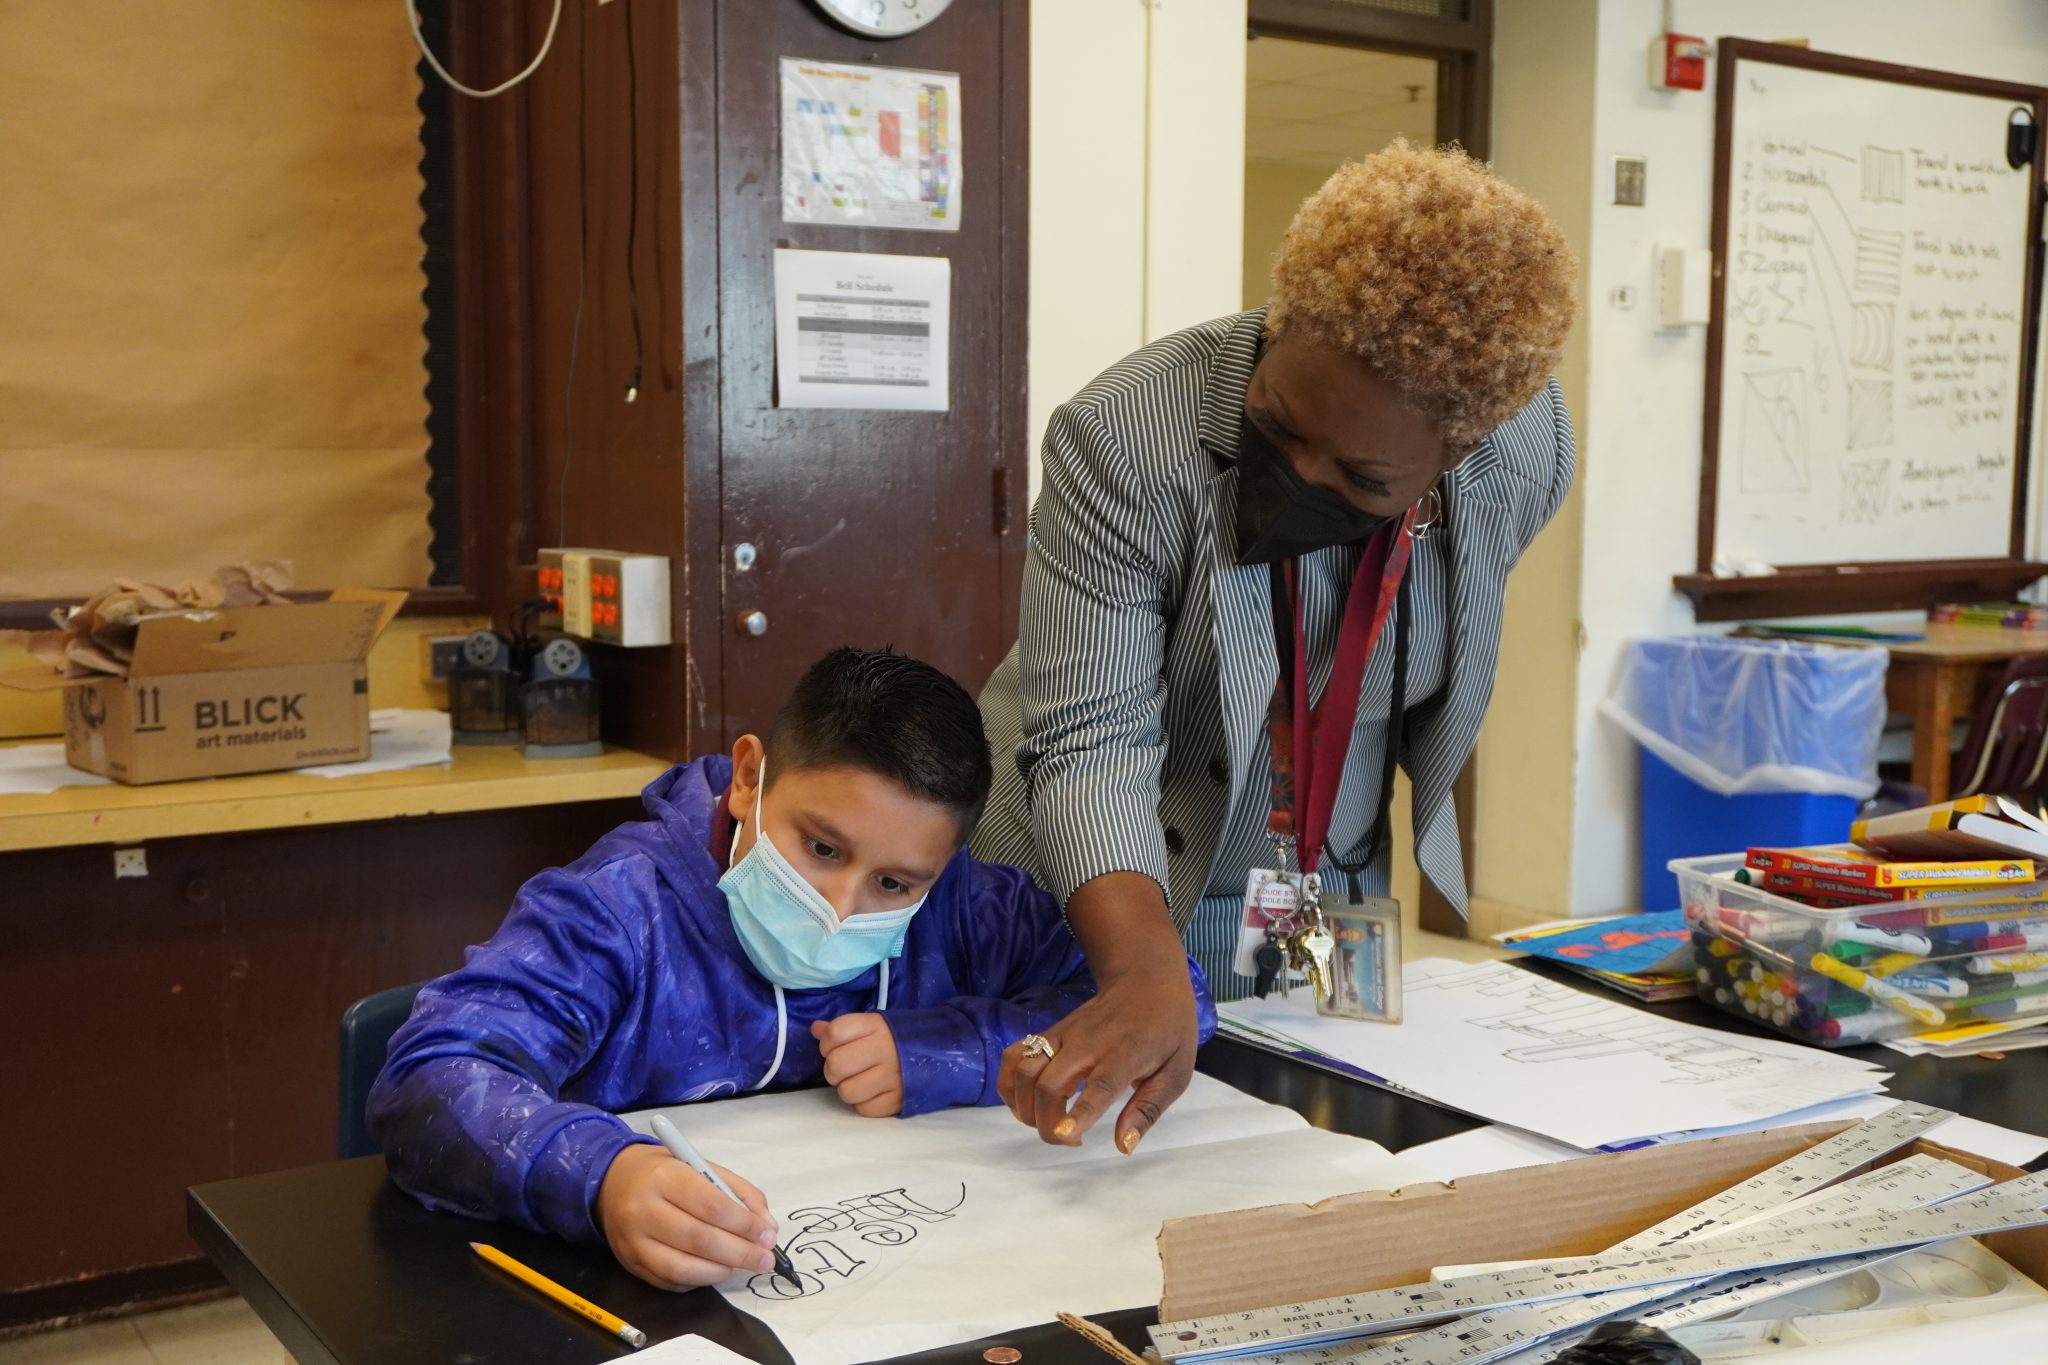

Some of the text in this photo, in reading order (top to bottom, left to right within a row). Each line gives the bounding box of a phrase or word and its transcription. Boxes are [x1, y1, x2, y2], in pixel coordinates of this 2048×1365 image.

[836, 280, 893, 292] Bell Schedule
[195, 694, 304, 729] BLICK
[195, 725, 307, 750] art materials
[1792, 862, 1811, 871] SUPER
[1811, 864, 1840, 876] Washable
[1840, 867, 1867, 878] Markers
[1898, 870, 1926, 880] SUPER
[1926, 869, 1962, 879] Washable
[1963, 868, 1991, 878] Markers
[1868, 888, 1894, 899] Markers
[1376, 985, 1385, 1010] College
[1687, 1210, 1705, 1220] 10
[1718, 1195, 1735, 1204] 11
[1747, 1180, 1766, 1190] 12
[1776, 1165, 1794, 1175] 13
[1804, 1151, 1822, 1161] 14
[1832, 1137, 1849, 1147] 15
[1859, 1123, 1877, 1133] 16
[1885, 1110, 1902, 1121] 17
[1806, 1206, 1826, 1216] 14
[1842, 1193, 1862, 1203] 15
[1879, 1182, 1899, 1192] 16
[1914, 1169, 1933, 1179] 17
[1913, 1194, 1925, 1202] 2
[2001, 1215, 2010, 1223] 1
[1954, 1222, 1965, 1230] 2
[1292, 1304, 1302, 1312] 3
[1344, 1297, 1353, 1305] 4
[1393, 1289, 1403, 1297] 5
[1443, 1281, 1453, 1289] 6
[1491, 1273, 1501, 1281] 7
[1590, 1258, 1600, 1266] 9
[1641, 1250, 1661, 1258] 10
[1687, 1242, 1709, 1251] 11
[1738, 1234, 1759, 1244] 12
[1785, 1228, 1805, 1236] 13
[1832, 1221, 1852, 1230] 14
[1879, 1214, 1898, 1222] 15
[1924, 1206, 1945, 1216] 16
[1971, 1199, 1989, 1209] 17
[1394, 1345, 1404, 1353] 4
[1438, 1330, 1449, 1339] 5
[1482, 1316, 1493, 1324] 6
[1981, 1187, 1999, 1198] 16
[2018, 1176, 2036, 1187] 17
[1554, 1253, 1692, 1279] MAYES
[1816, 1267, 1827, 1275] 7
[1617, 1273, 1628, 1281] 9
[1553, 1281, 1574, 1290] 10
[1504, 1289, 1525, 1298] 11
[1643, 1277, 1768, 1318] MAYES
[1730, 1294, 1742, 1302] 9
[1455, 1297, 1475, 1306] 12
[1283, 1314, 1311, 1323] MADE
[1326, 1306, 1358, 1317] U.S.A.
[1404, 1305, 1424, 1314] 13
[1675, 1308, 1696, 1319] 10
[1353, 1313, 1374, 1322] 14
[1547, 1315, 1568, 1325] 11
[1301, 1321, 1322, 1331] 15
[1249, 1329, 1270, 1338] 16
[1503, 1330, 1525, 1341] 12
[1198, 1337, 1218, 1347] 17
[1271, 1343, 1376, 1365] 2 3 4
[1460, 1345, 1481, 1356] 13
